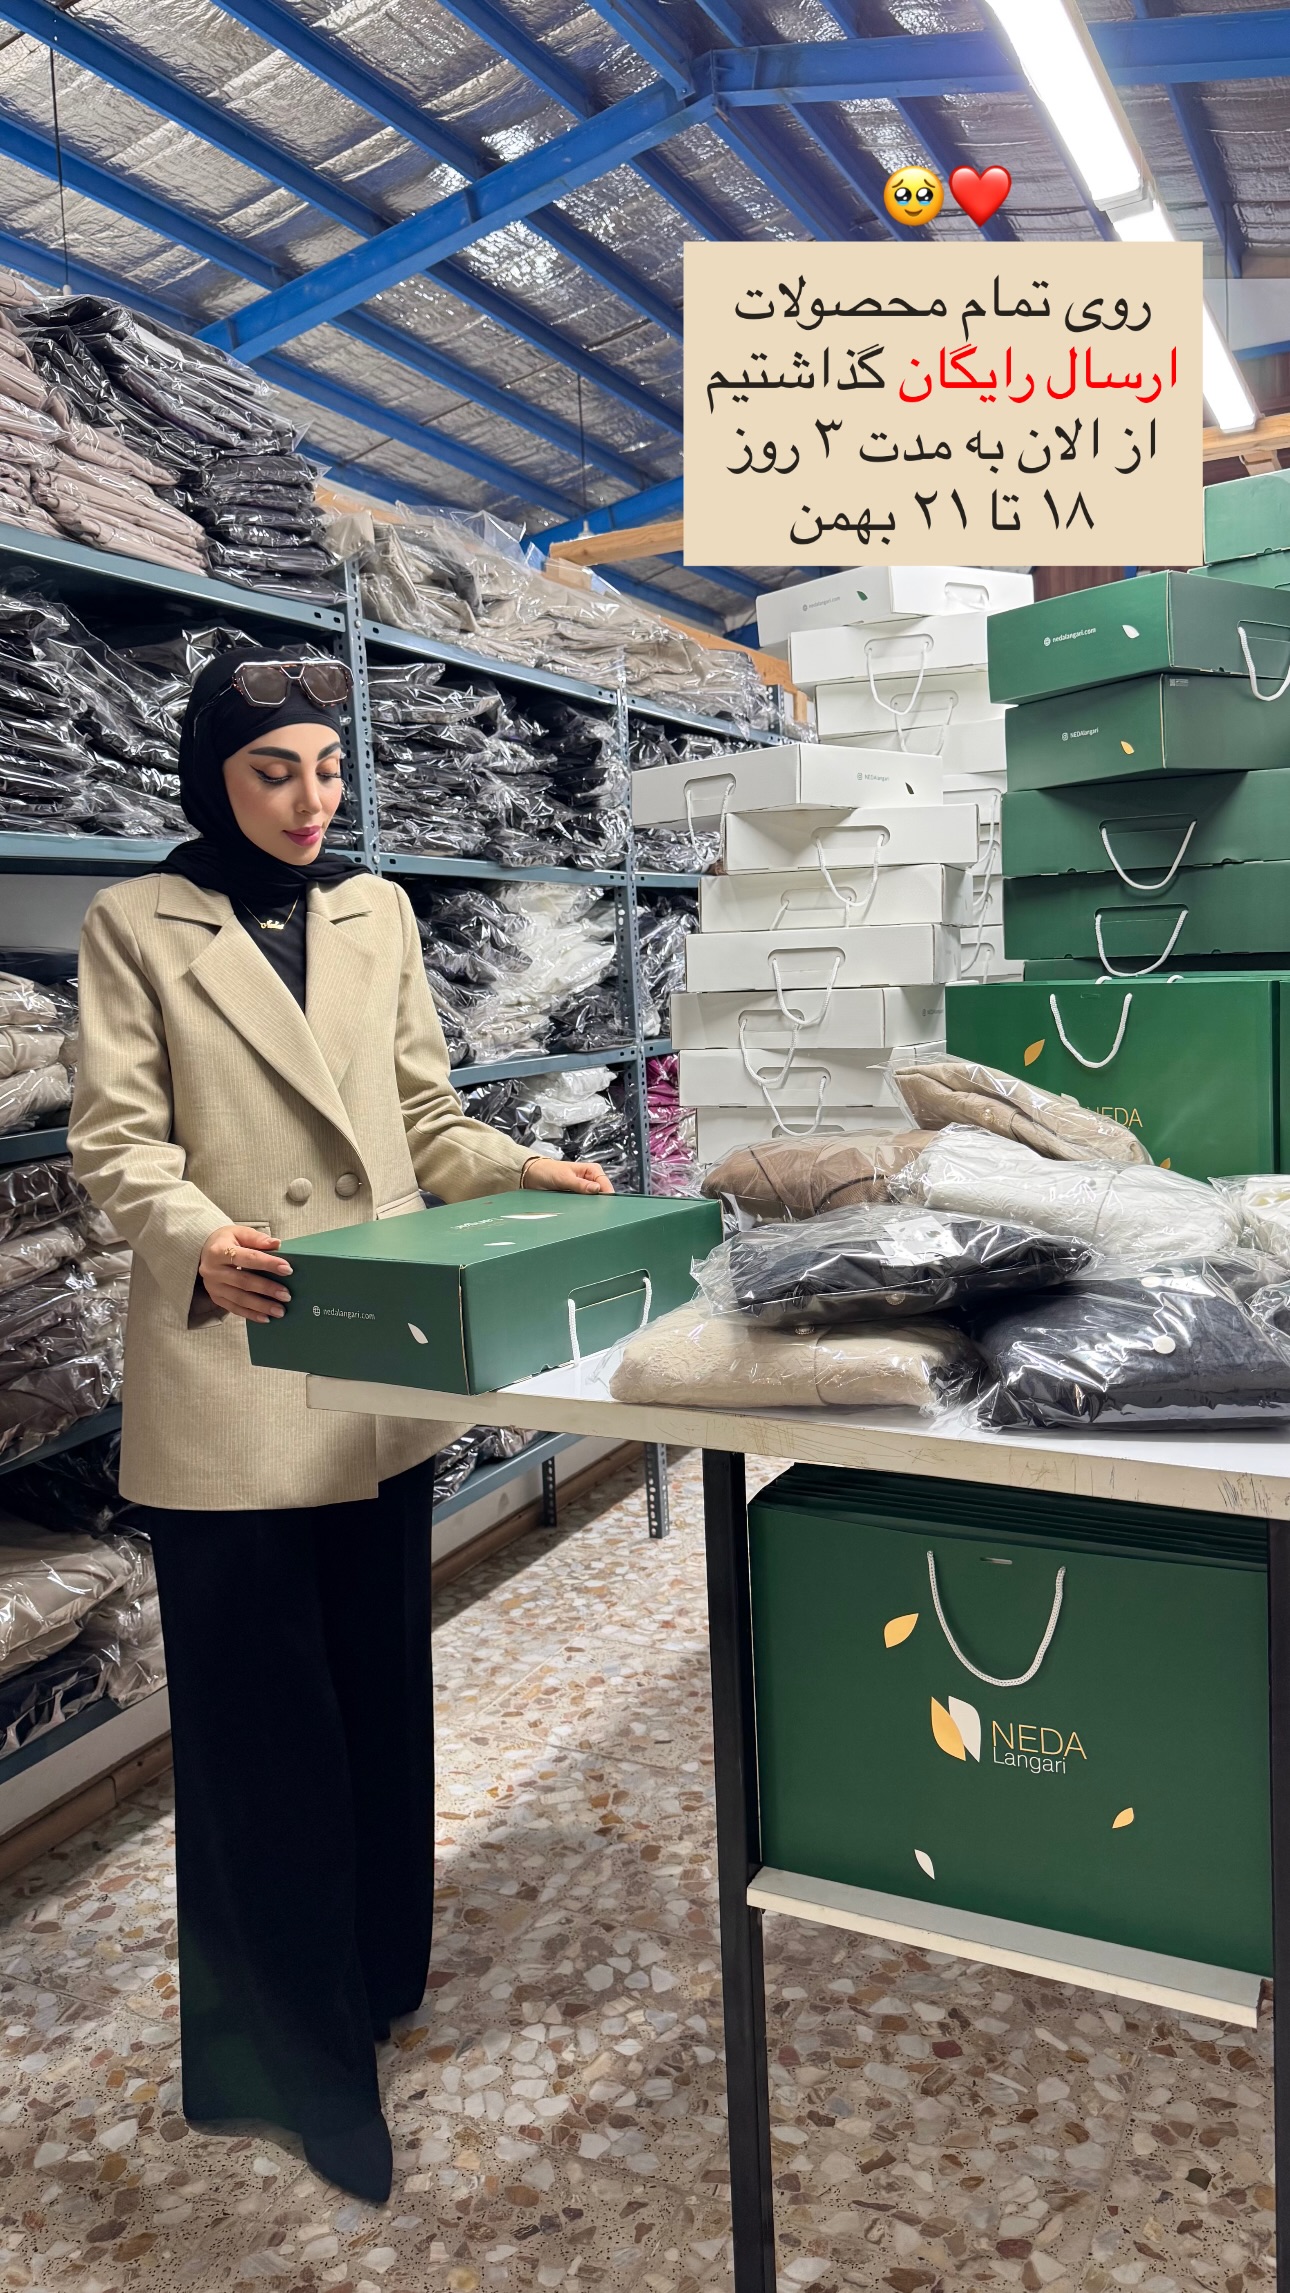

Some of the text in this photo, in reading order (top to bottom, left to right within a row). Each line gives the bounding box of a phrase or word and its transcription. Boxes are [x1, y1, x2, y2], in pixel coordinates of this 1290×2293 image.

[323, 1307, 377, 1320] nedalangari.com
[992, 1720, 1087, 1760] NEDA
[993, 1746, 1066, 1775] Langari
